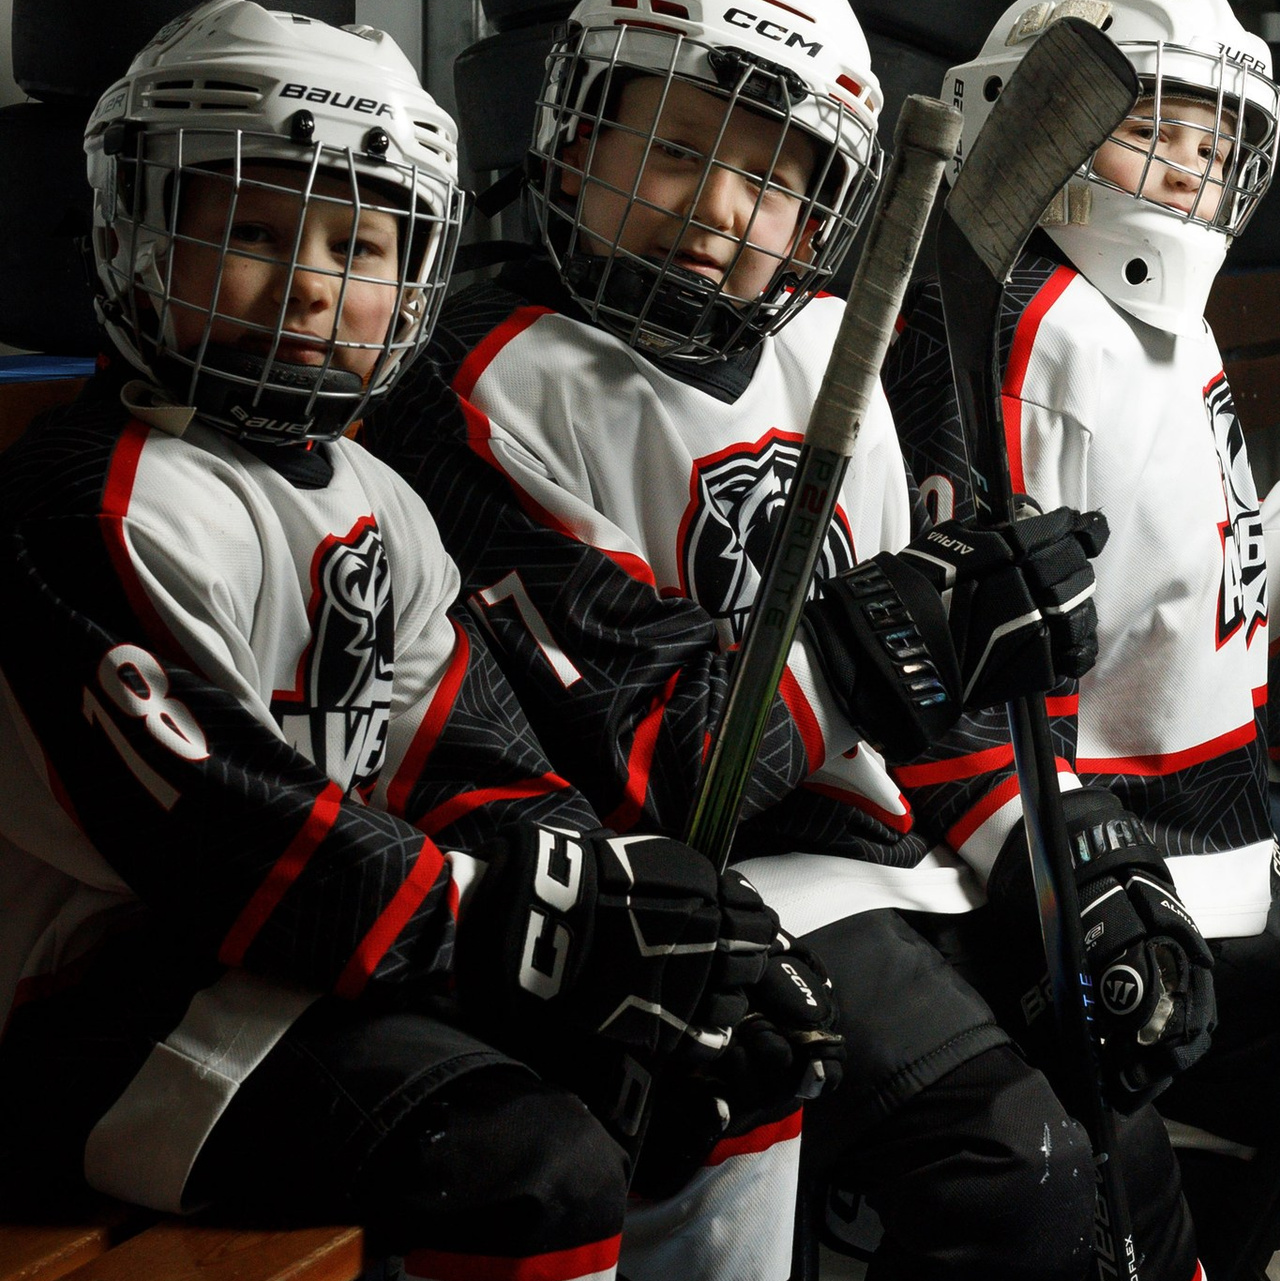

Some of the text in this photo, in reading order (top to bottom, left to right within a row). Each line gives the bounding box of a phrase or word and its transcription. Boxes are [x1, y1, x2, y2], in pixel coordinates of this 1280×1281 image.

[723, 8, 824, 58] CCM
[279, 83, 398, 120] BAUER
[230, 404, 316, 436] BAUE
[926, 530, 975, 556] ALPHA
[81, 641, 212, 814] 18
[517, 822, 584, 1001] CC
[1160, 899, 1199, 934] ALPHA
[780, 961, 818, 1008] CCM
[1124, 1234, 1137, 1274] FLEX
